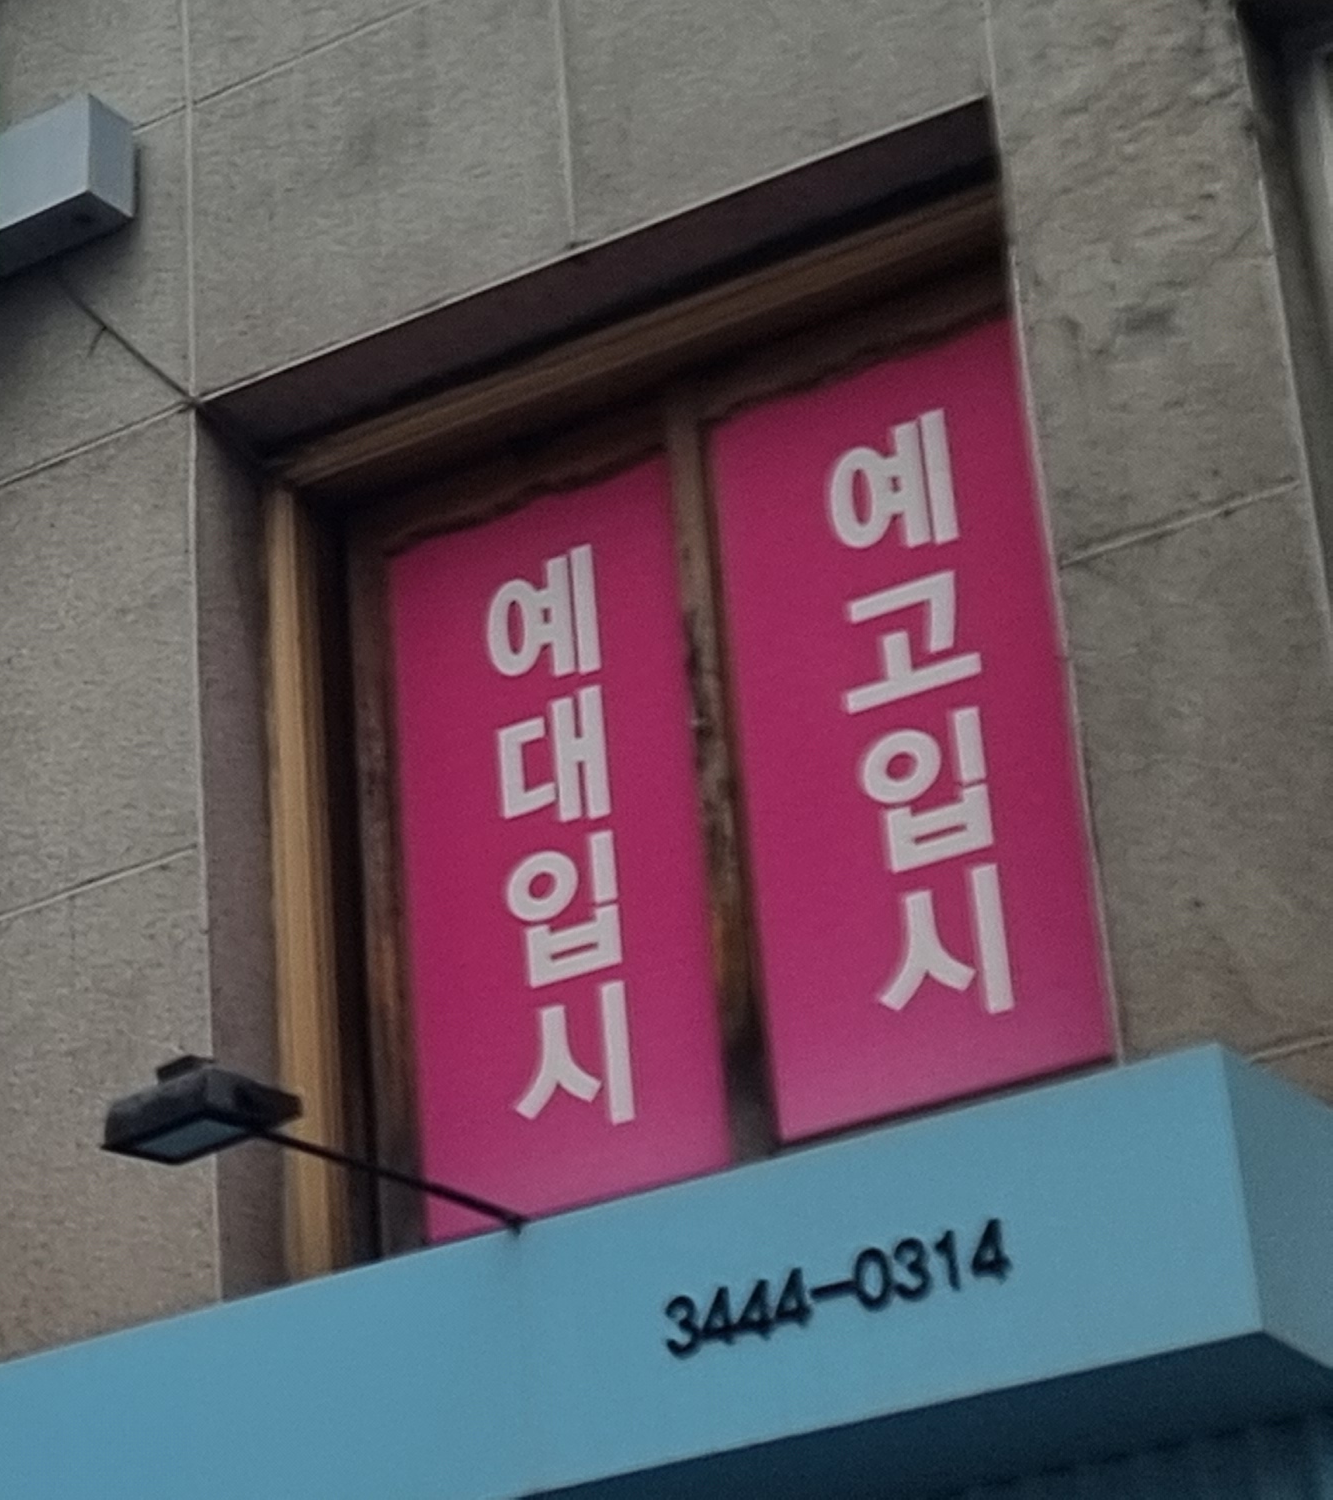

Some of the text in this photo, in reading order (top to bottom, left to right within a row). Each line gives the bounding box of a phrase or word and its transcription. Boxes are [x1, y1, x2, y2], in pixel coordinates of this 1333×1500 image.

[484, 542, 636, 1127] 예대입시
[825, 406, 1016, 1016] 예고입시
[664, 1217, 1013, 1358] 3444-0314
